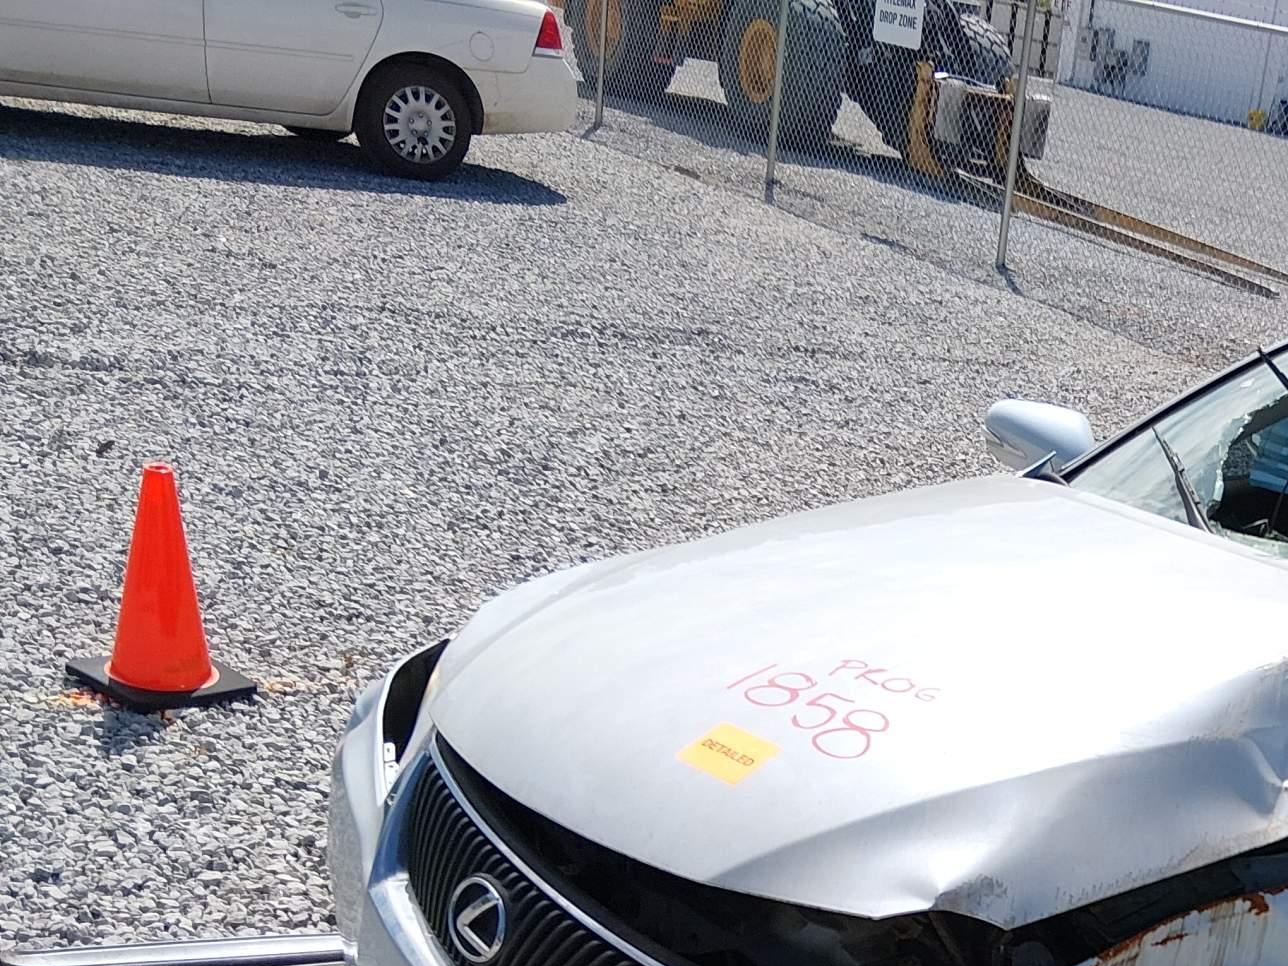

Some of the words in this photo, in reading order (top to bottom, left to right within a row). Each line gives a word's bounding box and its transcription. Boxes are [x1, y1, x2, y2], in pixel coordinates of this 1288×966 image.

[879, 9, 898, 25] DROP
[898, 13, 918, 30] ZONE
[726, 663, 890, 760] 1858
[701, 738, 754, 766] DETAILED
